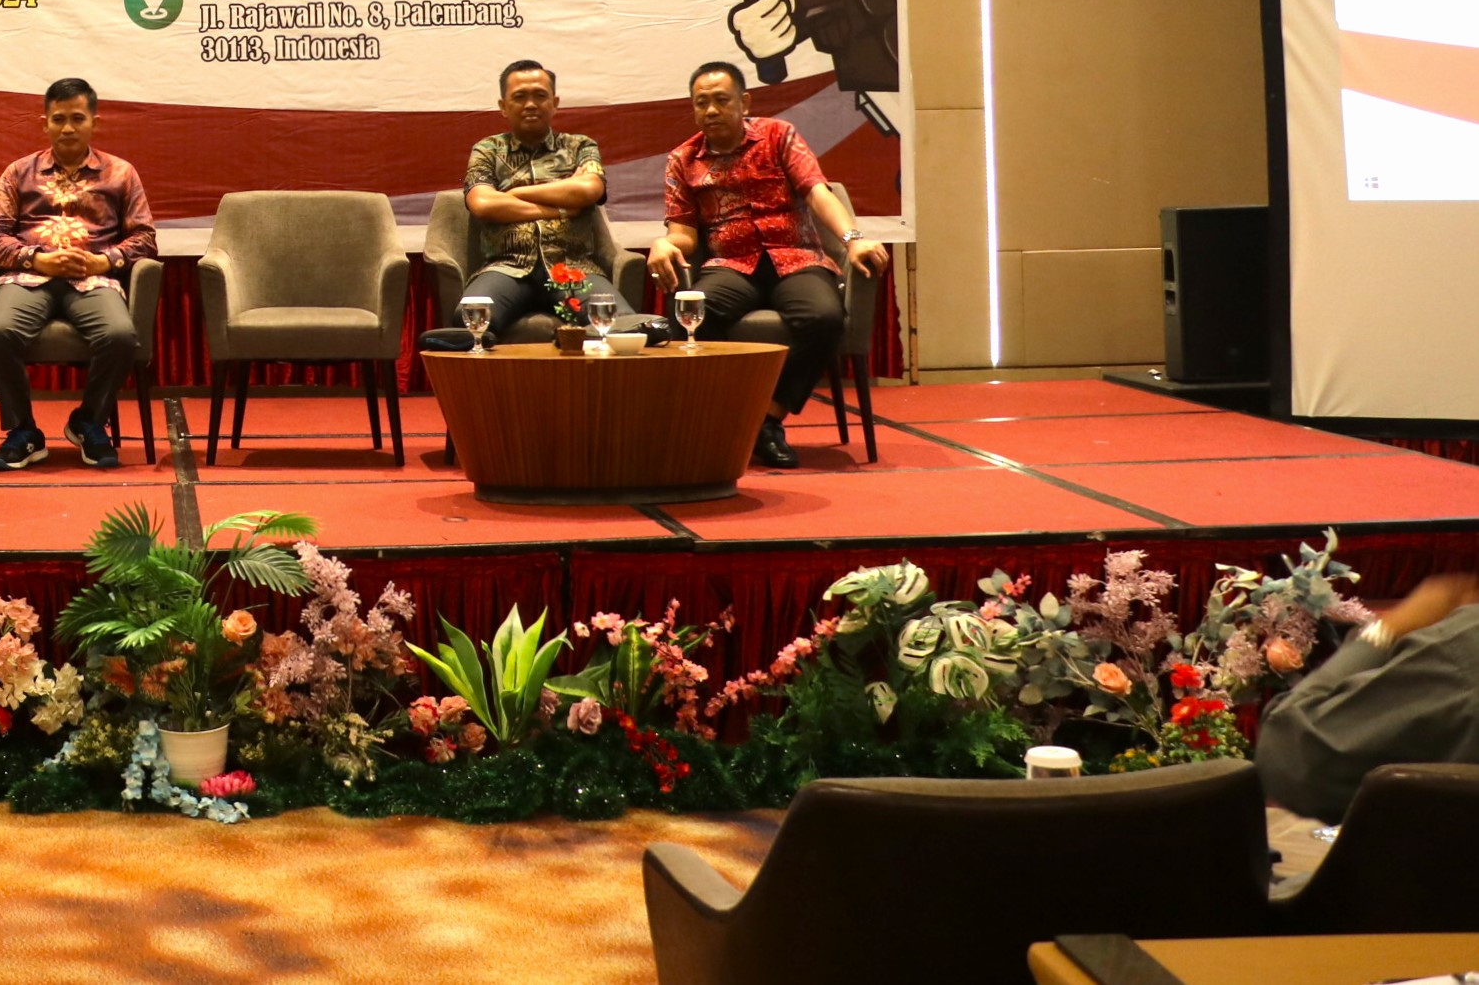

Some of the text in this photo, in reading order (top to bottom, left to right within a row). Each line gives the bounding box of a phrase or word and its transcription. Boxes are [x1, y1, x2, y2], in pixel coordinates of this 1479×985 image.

[199, 0, 523, 32] Jl. Rajawali No. 8, Palembang,
[201, 34, 380, 64] 30113, Indonesia
